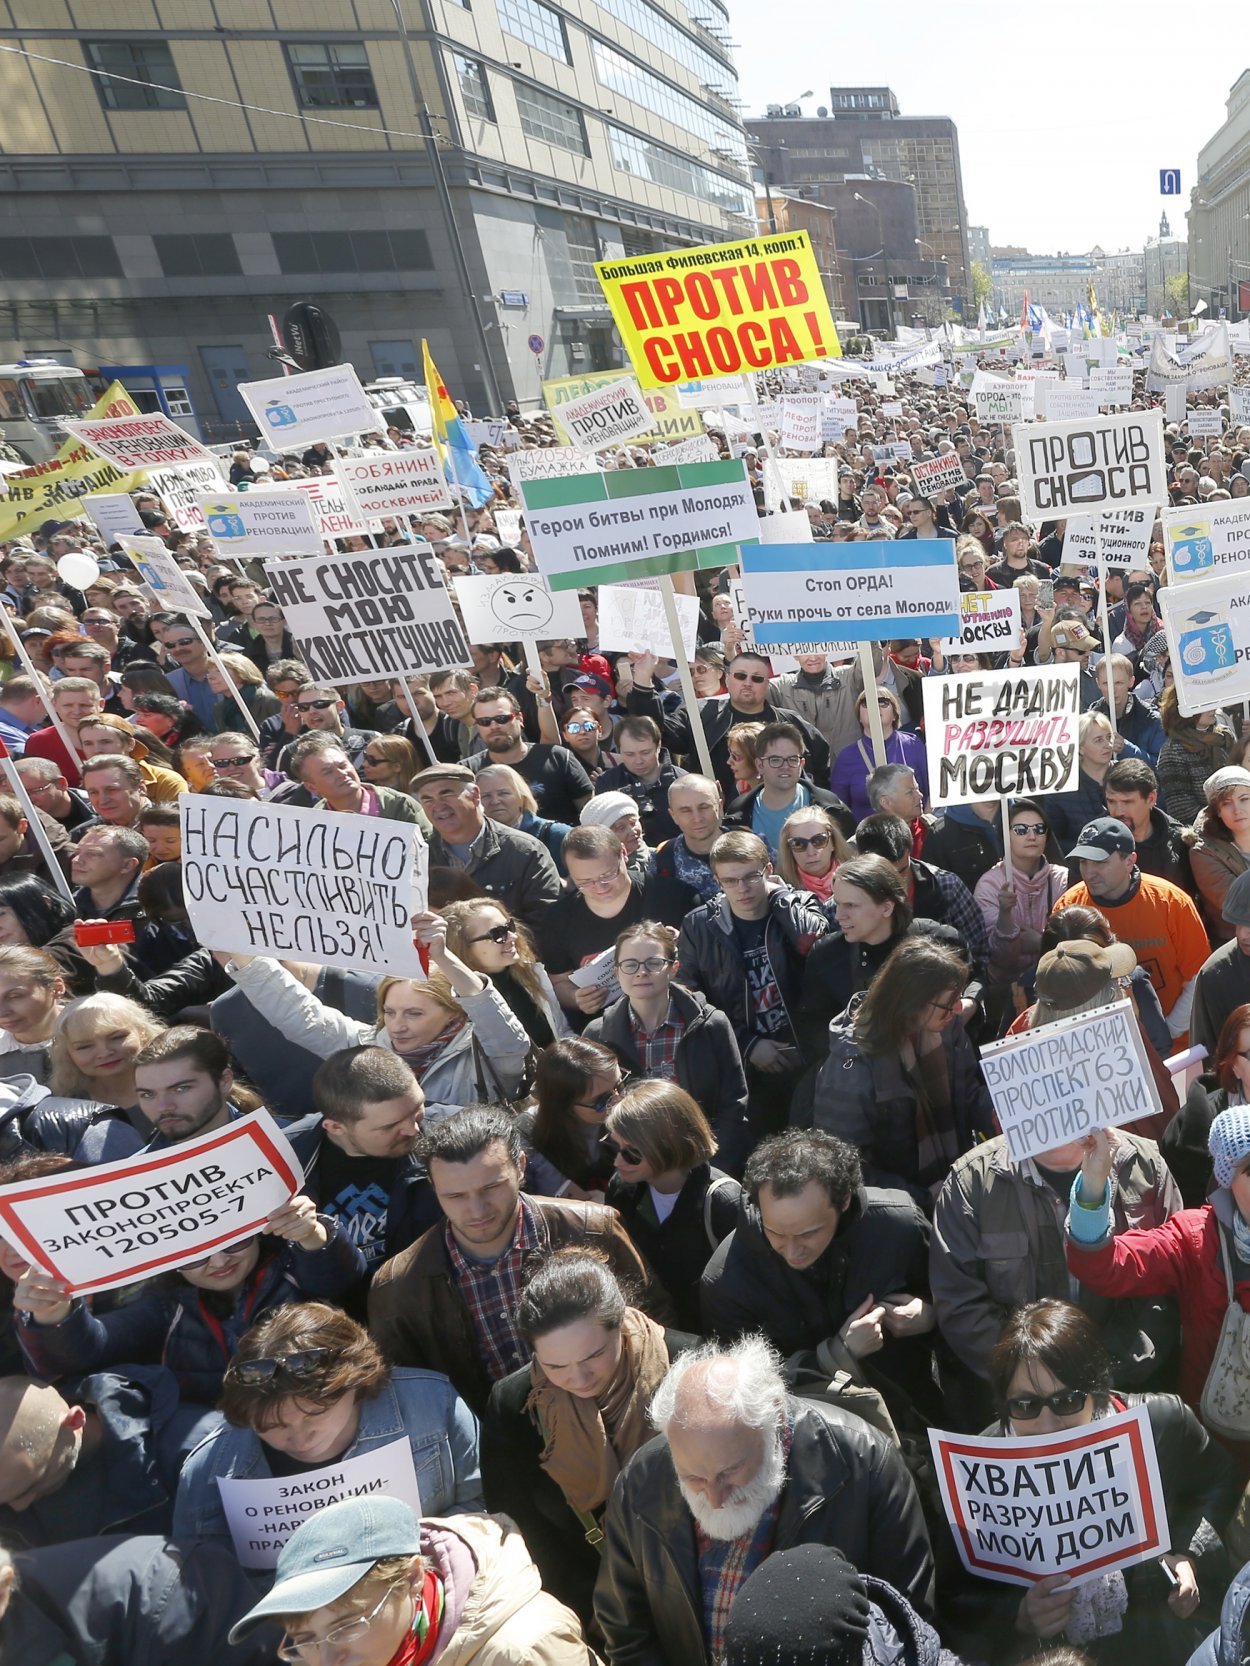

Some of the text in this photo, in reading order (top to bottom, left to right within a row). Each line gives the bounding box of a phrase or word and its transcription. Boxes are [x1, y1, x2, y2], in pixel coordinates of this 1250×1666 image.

[600, 236, 805, 280] Большая Филевская 14, корп.1
[620, 259, 809, 331] ПРОТИВ
[643, 317, 804, 383] СНОСА
[286, 381, 329, 394] АКАДЕМИЧЕСКИЙ
[294, 400, 317, 409] ПРОТИВ
[566, 387, 628, 421] АКАДЕМИЧЕСКИЙ
[80, 420, 173, 442] ЗАКОНОПРОЕКТ
[572, 398, 639, 436] ПРОТИВ
[98, 434, 191, 455] О РЕНОВАЦИИ
[117, 449, 188, 467] В ТОПКУ
[1029, 426, 1149, 474] ПРОТИВ
[411, 478, 439, 487] ПРАВА
[519, 462, 588, 478] БУМАЖКА
[915, 456, 958, 479] ОСТАНКИНО
[919, 468, 961, 487] ПРОТИВ
[921, 475, 965, 496] РЕНОВАЦИИ
[1034, 464, 1151, 508] СНОСА
[240, 500, 305, 508] АКАДЕМИЧЕСКИЙ
[254, 512, 295, 521] ПРОТИВ
[360, 489, 443, 511] МОСКВИЧЕЙ!
[247, 525, 314, 536] РЕНОВАЦИИ!
[530, 503, 679, 537] Герои битвы при
[573, 523, 733, 562] Помним! Гордимся!
[1070, 534, 1145, 549] консттуционного
[268, 553, 443, 607] НЕ СНОСИТЕ
[806, 575, 893, 593] Стоп ОРДА!
[323, 595, 415, 632] МОЮ
[748, 607, 782, 623] Руки
[788, 606, 832, 622] прочь
[837, 605, 851, 617] от
[857, 603, 891, 616] села
[296, 619, 470, 682] КОНСТИТУЦИЮ
[942, 677, 1078, 721] НЕ ДАДИМ
[943, 716, 1071, 755] РАЗРУШИТЬ
[939, 744, 1075, 798] МОСКВУ
[186, 807, 407, 880] НАСИЛЬНО
[185, 861, 408, 928] ОСЧАСТЛИВИТЬ
[241, 910, 389, 964] НЕЛЬЗЯ!
[984, 1015, 1128, 1087] ВОЛГОГРАДСКИЙ
[993, 1045, 1134, 1120] ПРОСПЕКТ 63
[1006, 1077, 1148, 1156] ПРОТИВ ЛЖИ
[42, 1167, 274, 1254] ЗАКОНОПРОЕКТА
[64, 1164, 227, 1227] ПРОТИВ
[95, 1195, 248, 1259] 120505-7
[278, 1474, 345, 1498] ЗАКОН
[960, 1443, 1119, 1498] ХВАТИТ
[245, 1507, 258, 1518] О
[967, 1487, 1129, 1528] РАЗРУШАТЬ
[976, 1512, 1135, 1566] МОЙ ДОМ
